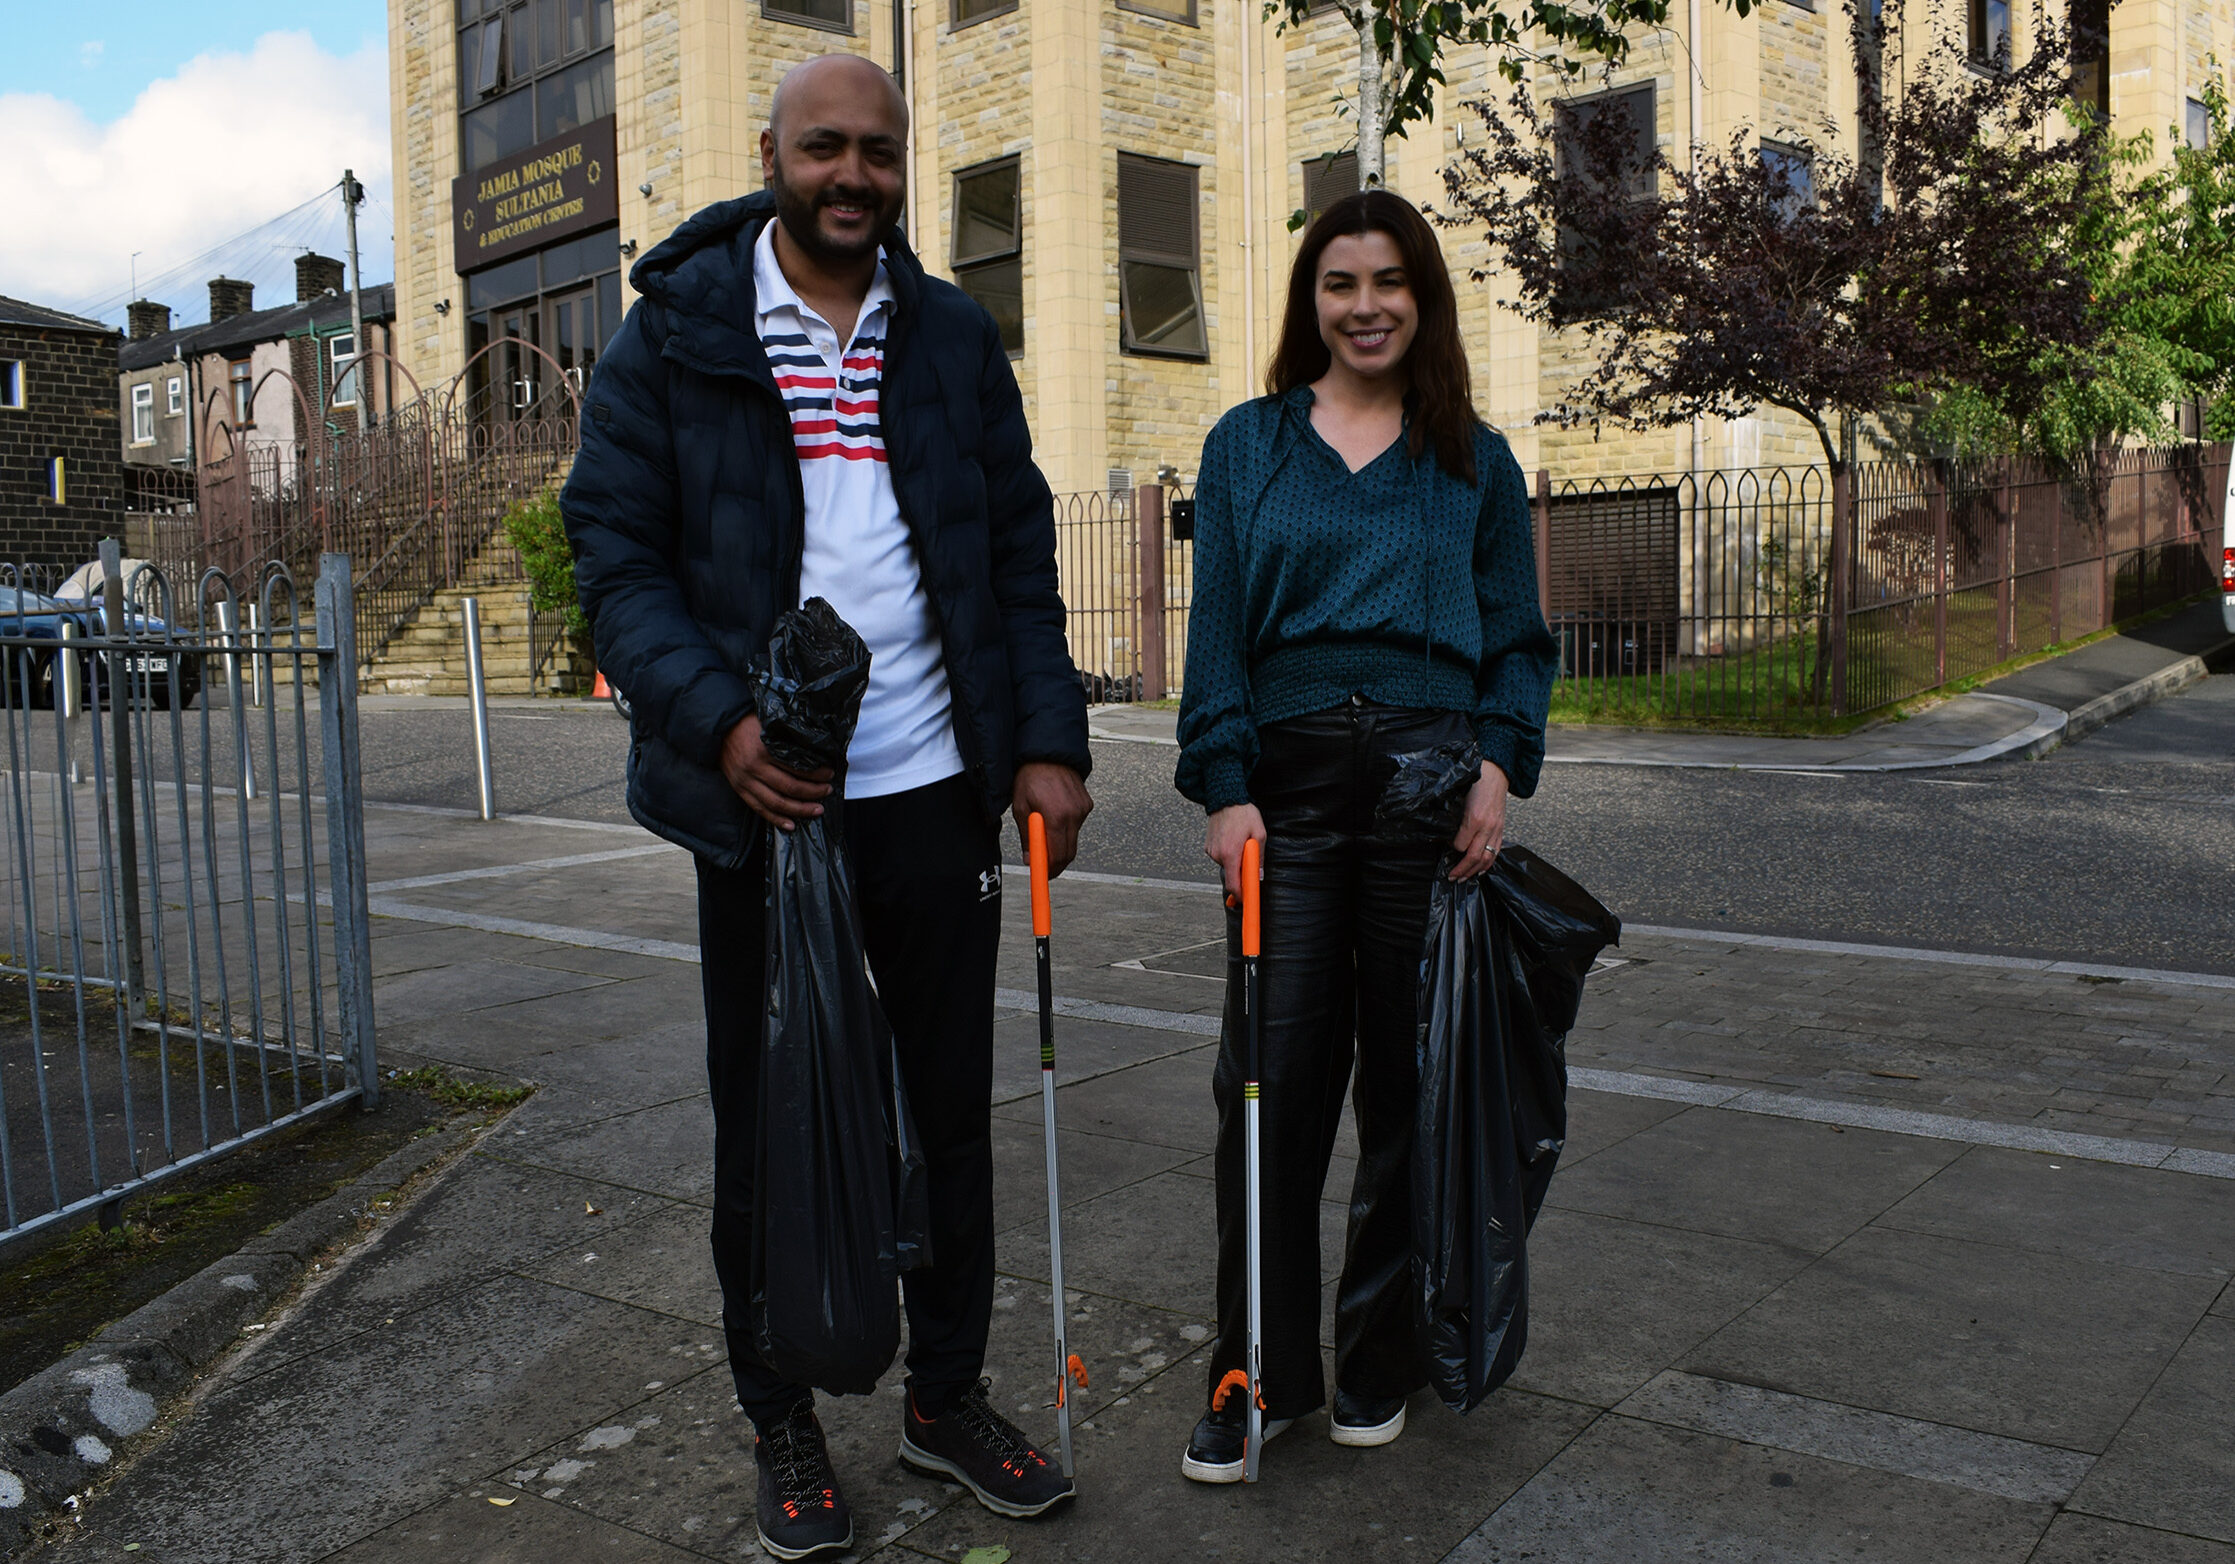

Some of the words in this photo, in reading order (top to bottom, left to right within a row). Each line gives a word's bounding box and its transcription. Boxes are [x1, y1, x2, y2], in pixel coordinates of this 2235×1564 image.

[477, 169, 520, 203] JAMIA
[522, 143, 583, 186] MOSQUE
[479, 232, 487, 248] &
[487, 211, 543, 246] EDUCATION
[543, 197, 584, 225] CENTRE
[495, 179, 565, 223] SULTANIA
